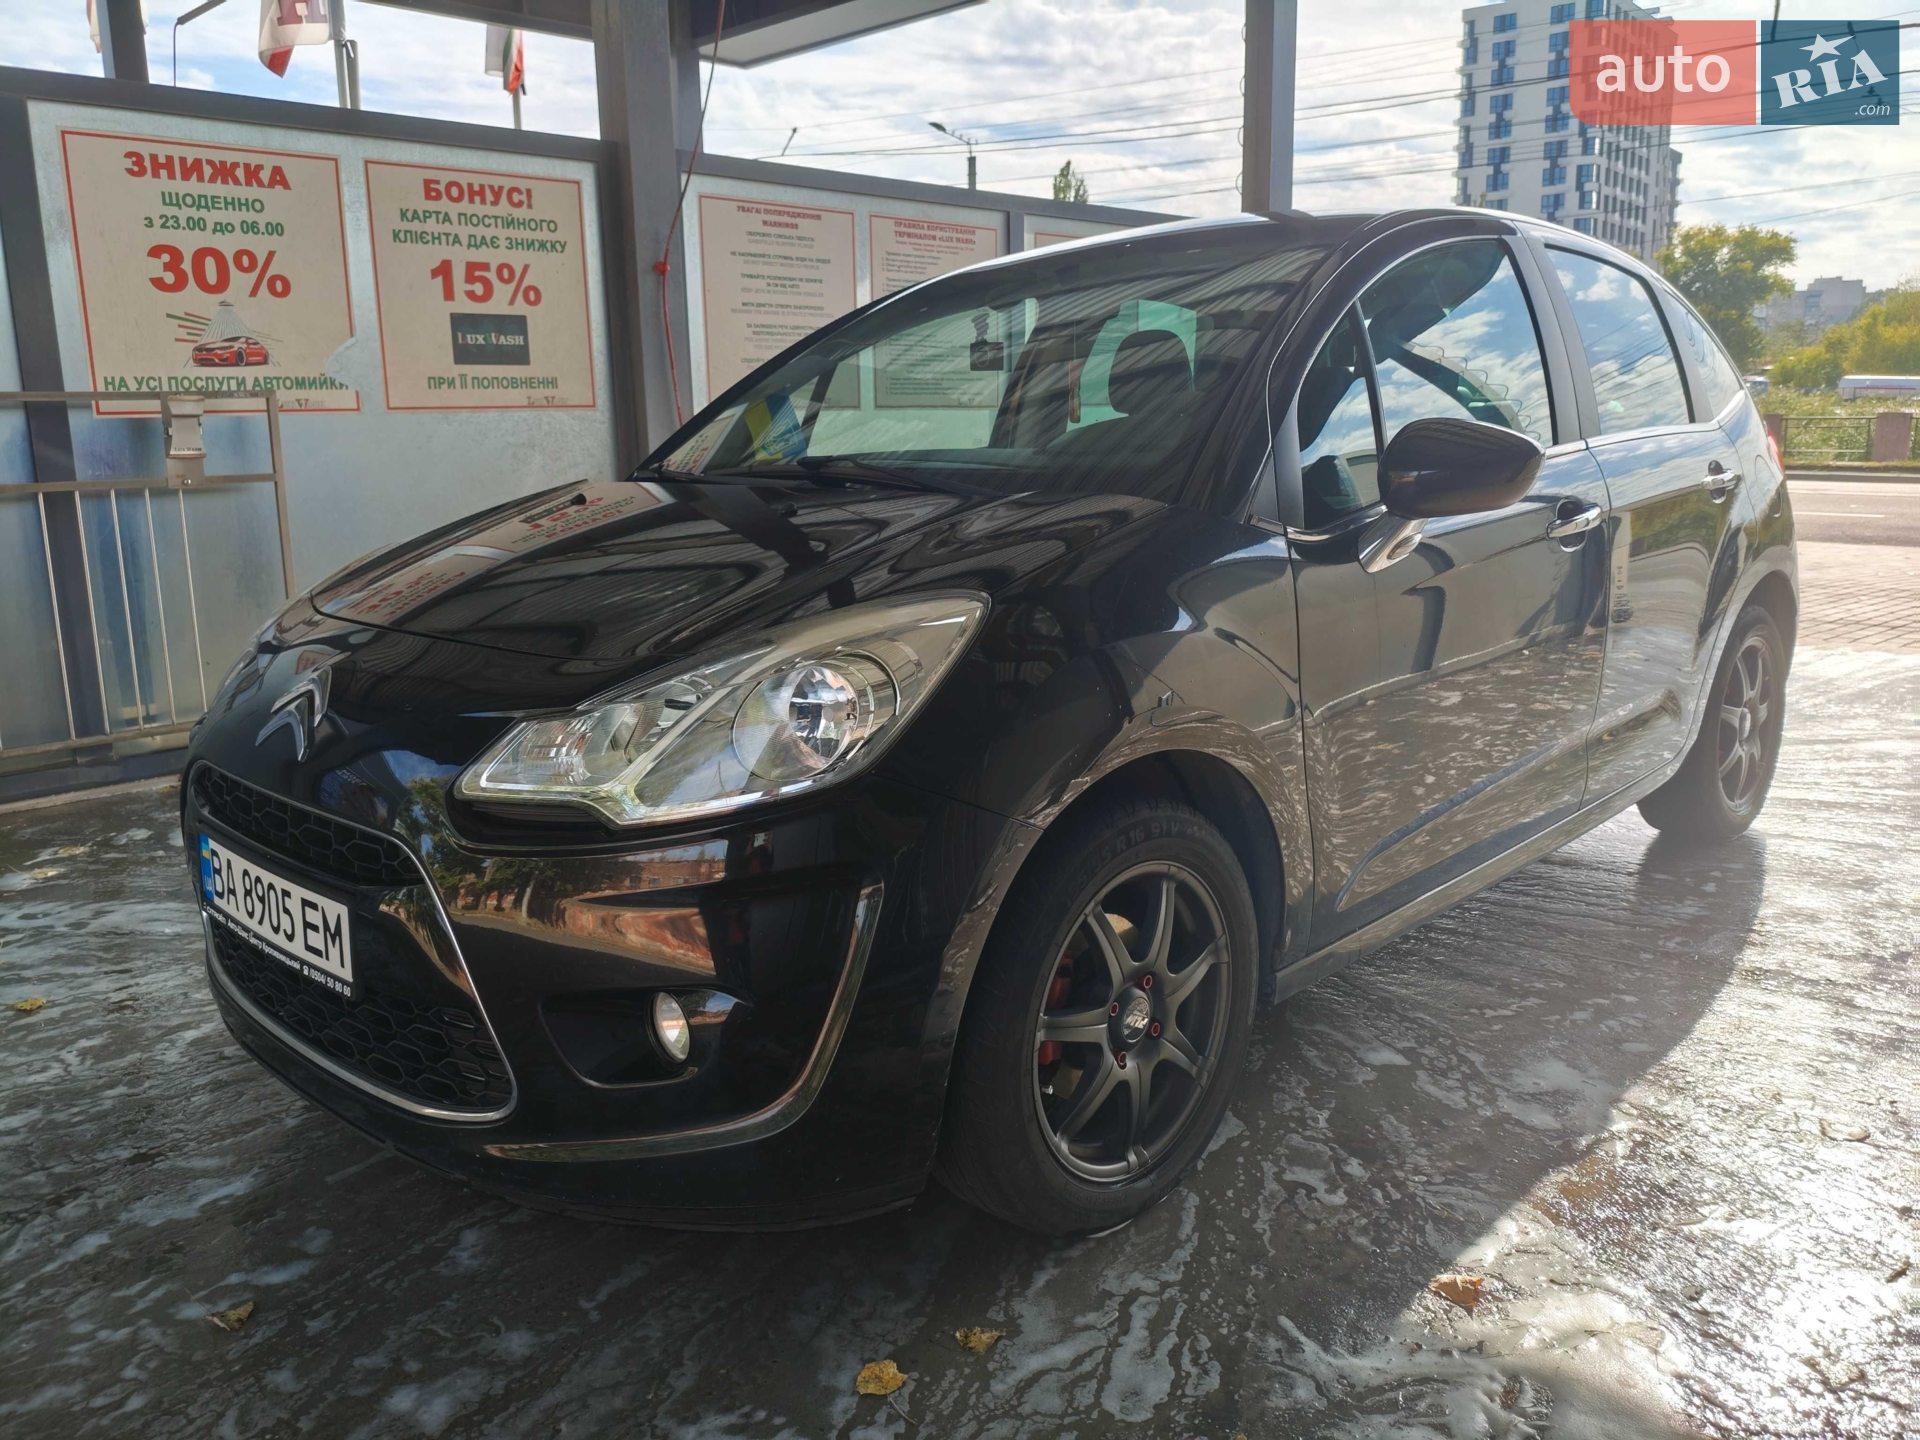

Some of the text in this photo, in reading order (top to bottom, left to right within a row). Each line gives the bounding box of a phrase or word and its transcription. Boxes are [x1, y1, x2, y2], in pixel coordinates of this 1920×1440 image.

[123, 150, 292, 190] ЗНИЖКА
[161, 191, 265, 213] ЩОДЕННО
[423, 178, 534, 209] БОНУС!
[143, 214, 285, 237] з 23.00 до 06.00
[400, 208, 558, 233] КАРТА ПОСТІЙНОГО
[762, 219, 799, 230] WARNINGS
[894, 221, 925, 231] ПРАВИЛА
[392, 229, 567, 254] КЛІЄНТА ДАЄ ЗНИЖКУ
[146, 244, 292, 299] 30%
[430, 259, 542, 307] 15%
[103, 376, 131, 391] НА
[135, 375, 163, 391] УСІ
[168, 375, 246, 391] ПОСЛУГИ
[427, 374, 558, 389] ПРИ ЇЇ ПОПОВНЕННІ
[203, 874, 213, 892] UA
[210, 848, 346, 969] BA 8905 EM
[326, 977, 335, 989] 50
[334, 980, 343, 993] 80
[343, 984, 351, 997] 60
